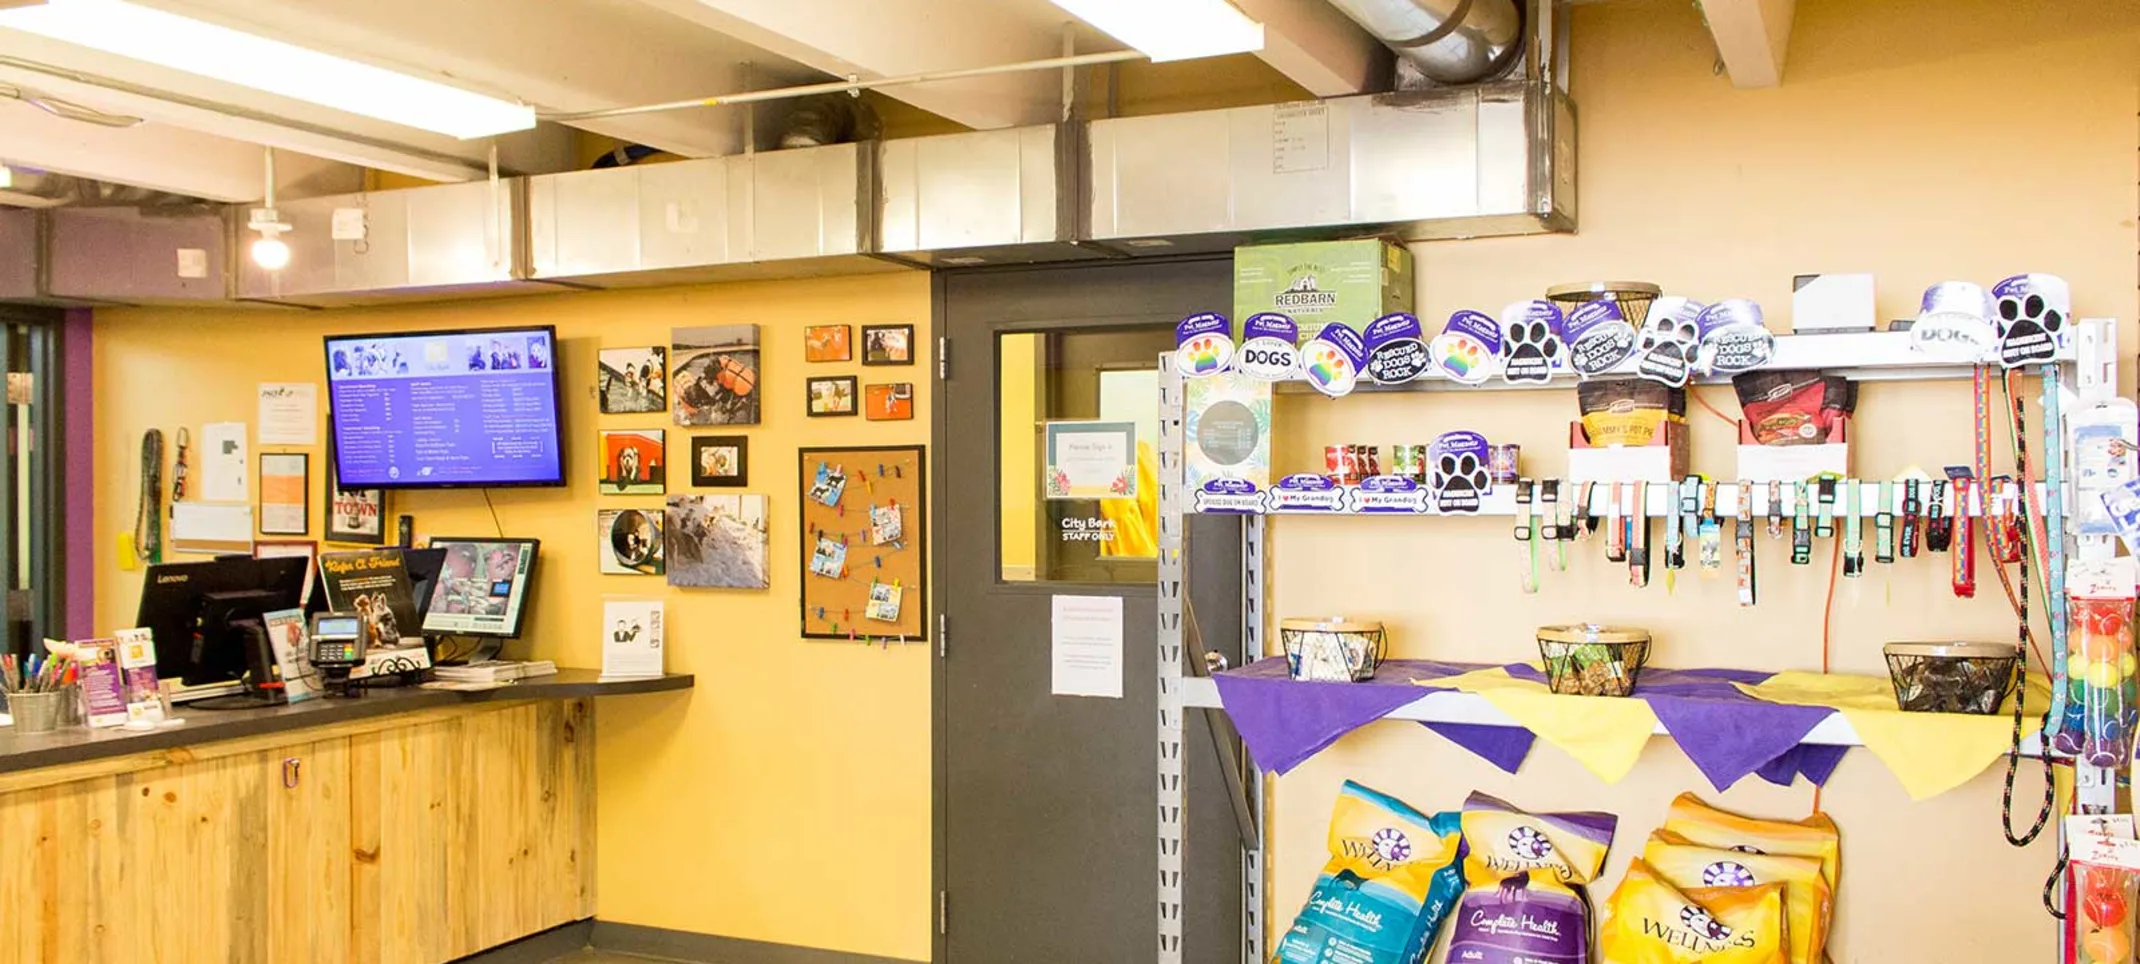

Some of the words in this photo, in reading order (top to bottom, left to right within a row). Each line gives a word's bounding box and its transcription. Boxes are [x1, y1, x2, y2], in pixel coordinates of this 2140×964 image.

[1275, 293, 1336, 306] REDBARN
[1921, 327, 1978, 346] DOG
[1377, 342, 1418, 359] RESCUED
[1588, 339, 1615, 359] DOGS
[1245, 349, 1292, 367] DOGS
[1382, 355, 1411, 369] DOGS
[1589, 349, 1622, 370] ROCK
[1716, 354, 1751, 367] ROCK
[1382, 366, 1413, 379] ROCK
[335, 502, 377, 516] TOWN
[1062, 518, 1086, 530] City
[1088, 518, 1115, 528] Bark
[1062, 532, 1090, 541] STAFF
[1091, 532, 1115, 541] ONLY
[157, 574, 189, 584] Lenovo
[1345, 901, 1384, 929] Health
[1470, 909, 1518, 935] Complete
[1520, 914, 1562, 936] Health
[1461, 951, 1484, 960] Adult
